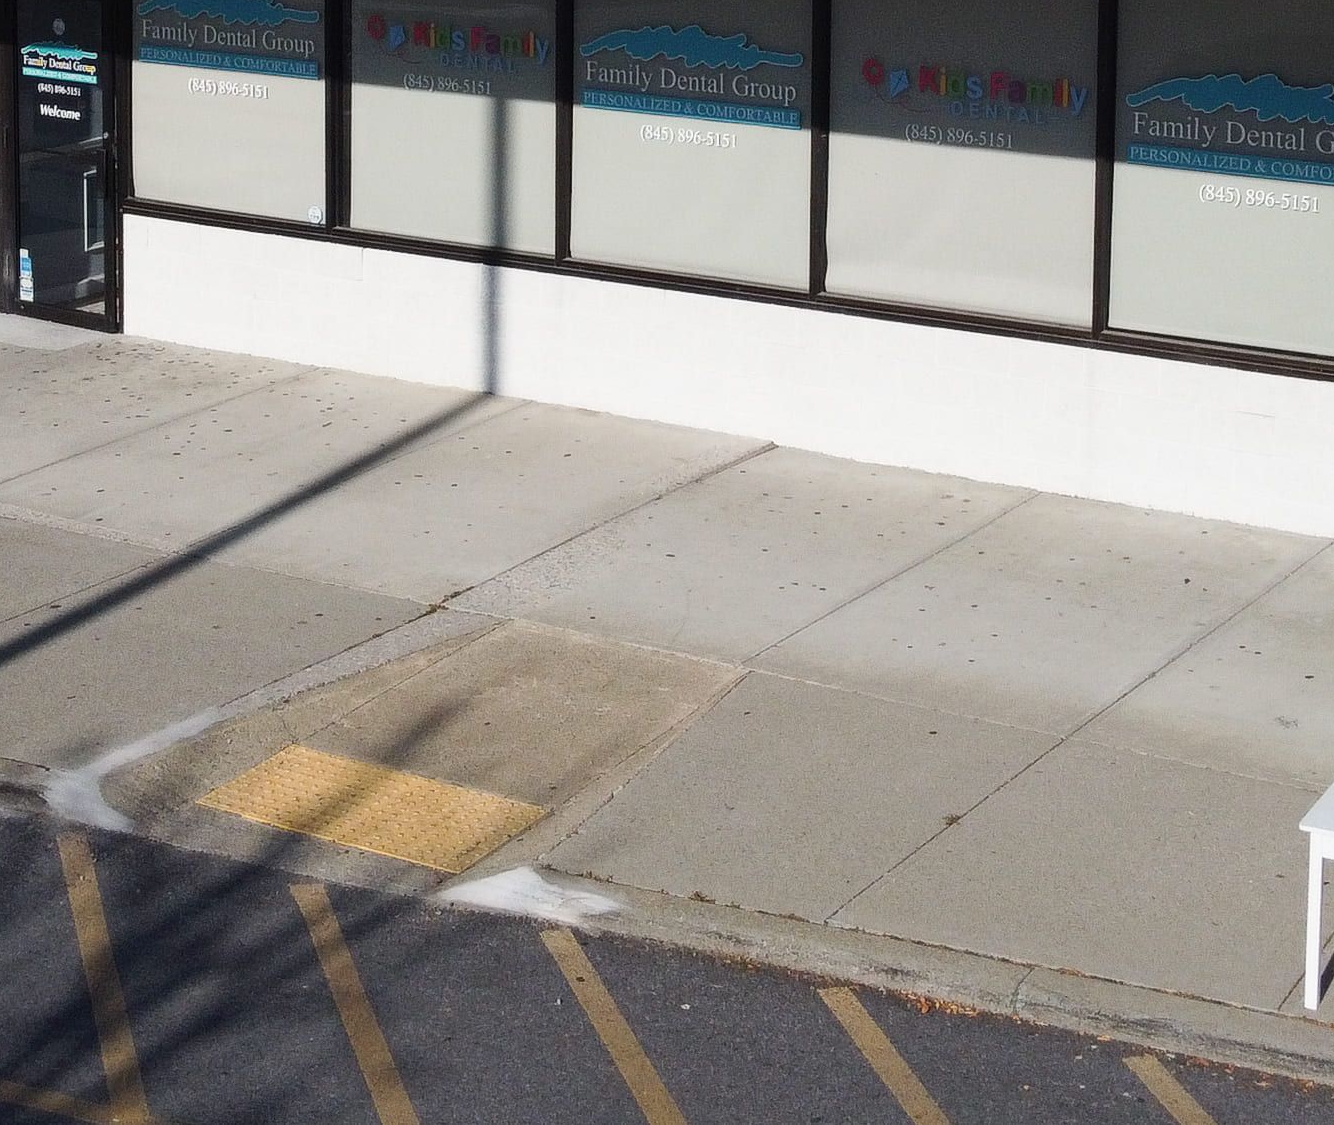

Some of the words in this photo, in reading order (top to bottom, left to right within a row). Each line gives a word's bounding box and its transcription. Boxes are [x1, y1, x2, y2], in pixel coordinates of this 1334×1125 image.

[141, 19, 198, 47] Family
[204, 25, 256, 48] Dental
[262, 30, 315, 58] Group
[23, 55, 47, 69] Family
[49, 58, 72, 70] Dental
[72, 61, 96, 76] Group
[140, 47, 218, 66] PERSONALIZED
[223, 55, 231, 66] &
[234, 57, 316, 75] COMFORTABLE
[188, 78, 217, 94] (845)
[219, 81, 269, 99] 896-5151
[403, 73, 434, 92] (845)
[437, 77, 492, 95] 896-5151
[586, 61, 653, 92] Family
[660, 68, 724, 94] Dental
[732, 75, 796, 107] Group
[919, 63, 983, 100] Kids
[990, 71, 1088, 117] Family
[40, 104, 81, 120] Welcome
[583, 91, 682, 113] PERSONALIZED
[683, 103, 693, 115] &
[696, 104, 799, 124] COMFORTABLE
[639, 125, 674, 145] (845)
[677, 128, 737, 148] 896-5151
[905, 124, 943, 145] (845)
[947, 128, 1013, 149] 896-5151
[1132, 112, 1217, 148] Family
[1225, 121, 1305, 152] Dental
[1129, 146, 1252, 172] PERSONALIZED
[1254, 159, 1267, 173] &
[1199, 184, 1242, 208] (845)
[1245, 189, 1320, 213] 896-5151
